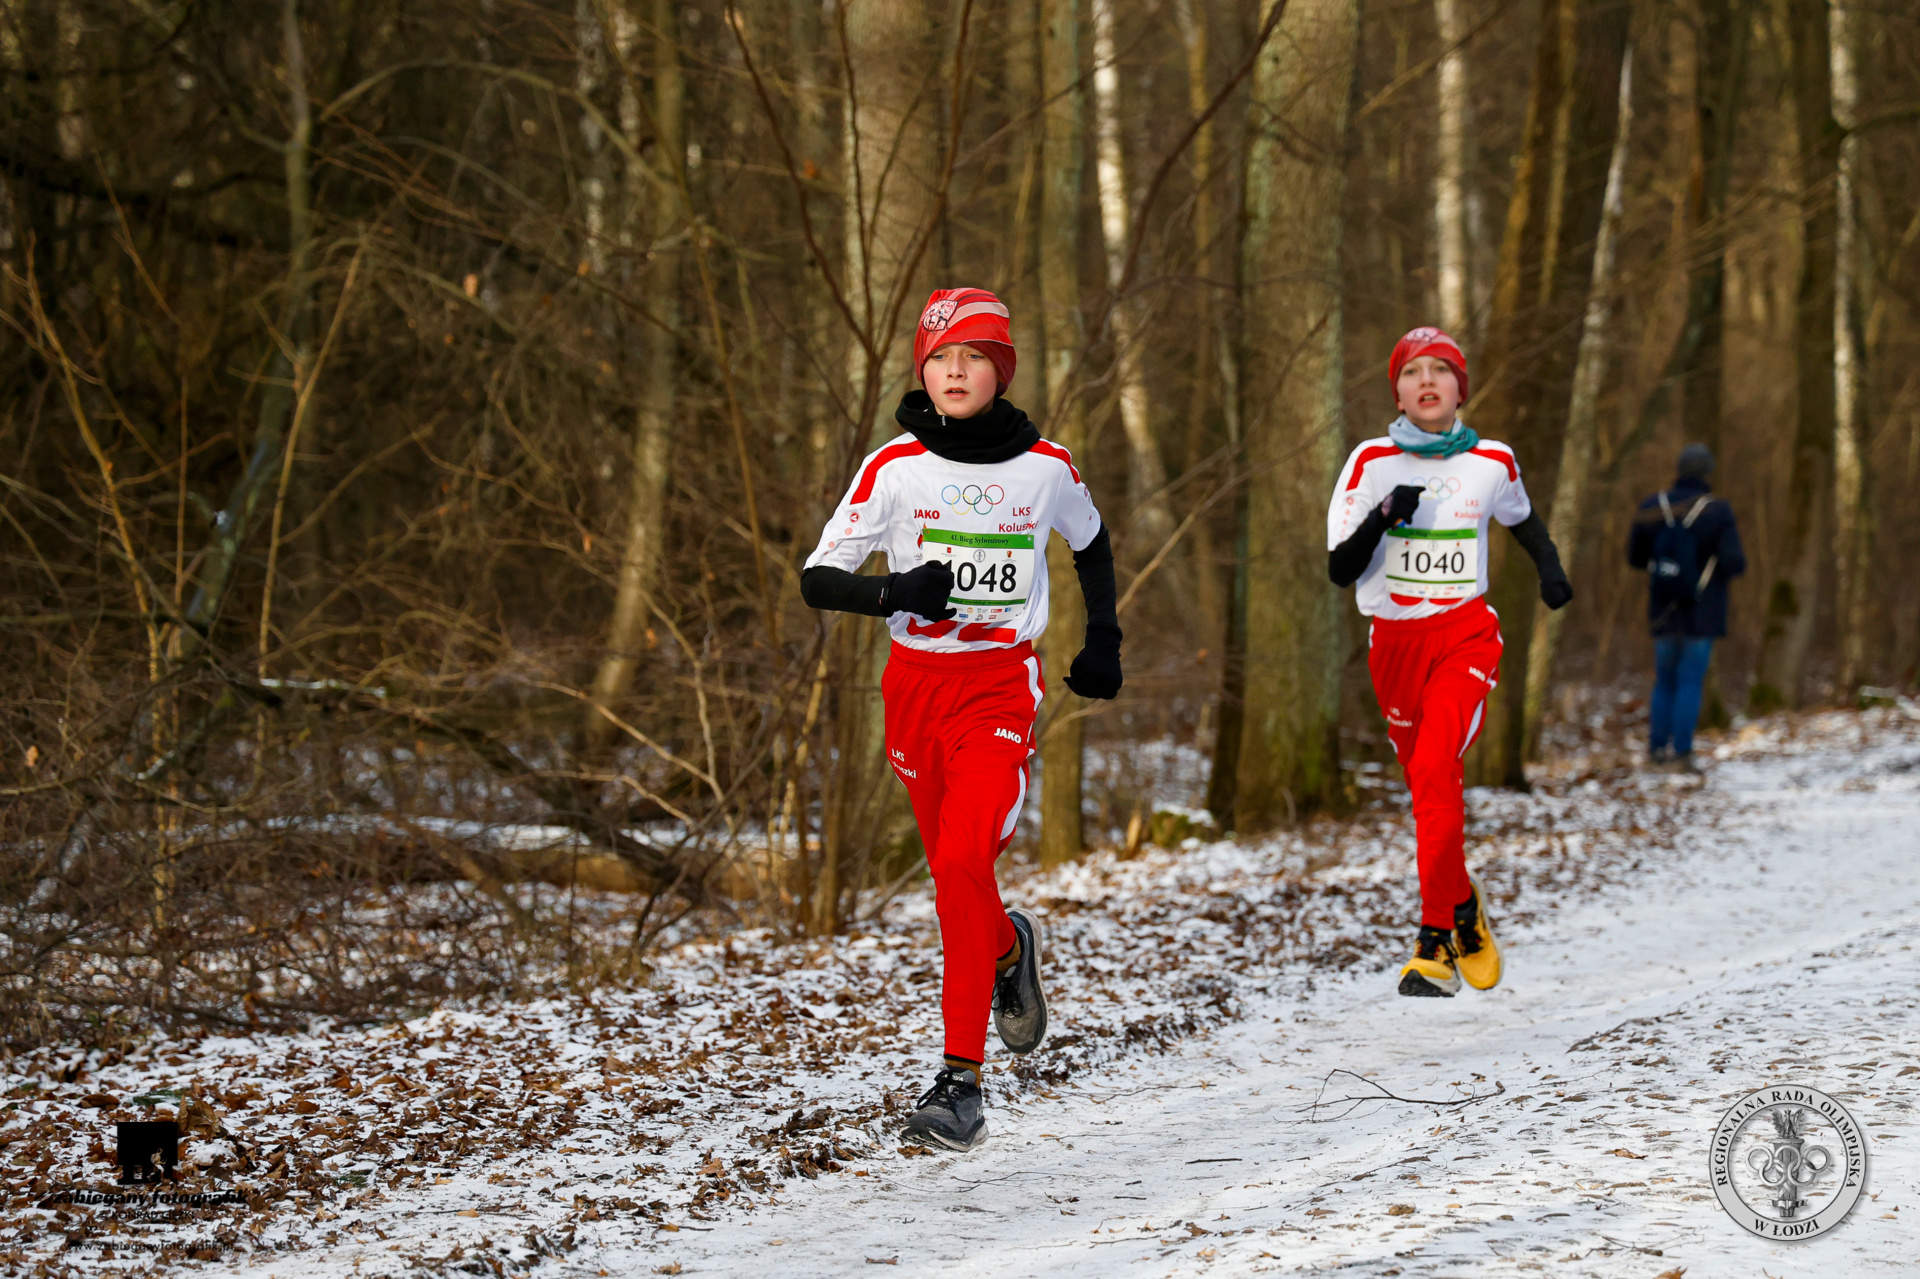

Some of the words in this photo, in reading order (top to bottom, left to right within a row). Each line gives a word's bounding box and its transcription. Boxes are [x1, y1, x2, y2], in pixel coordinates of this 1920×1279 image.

[913, 508, 940, 520] JAKO
[1012, 506, 1031, 517] LKS
[1400, 551, 1465, 574] 1040
[945, 560, 1017, 593] 048
[993, 727, 1022, 744] JAKO
[891, 747, 905, 762] LKS
